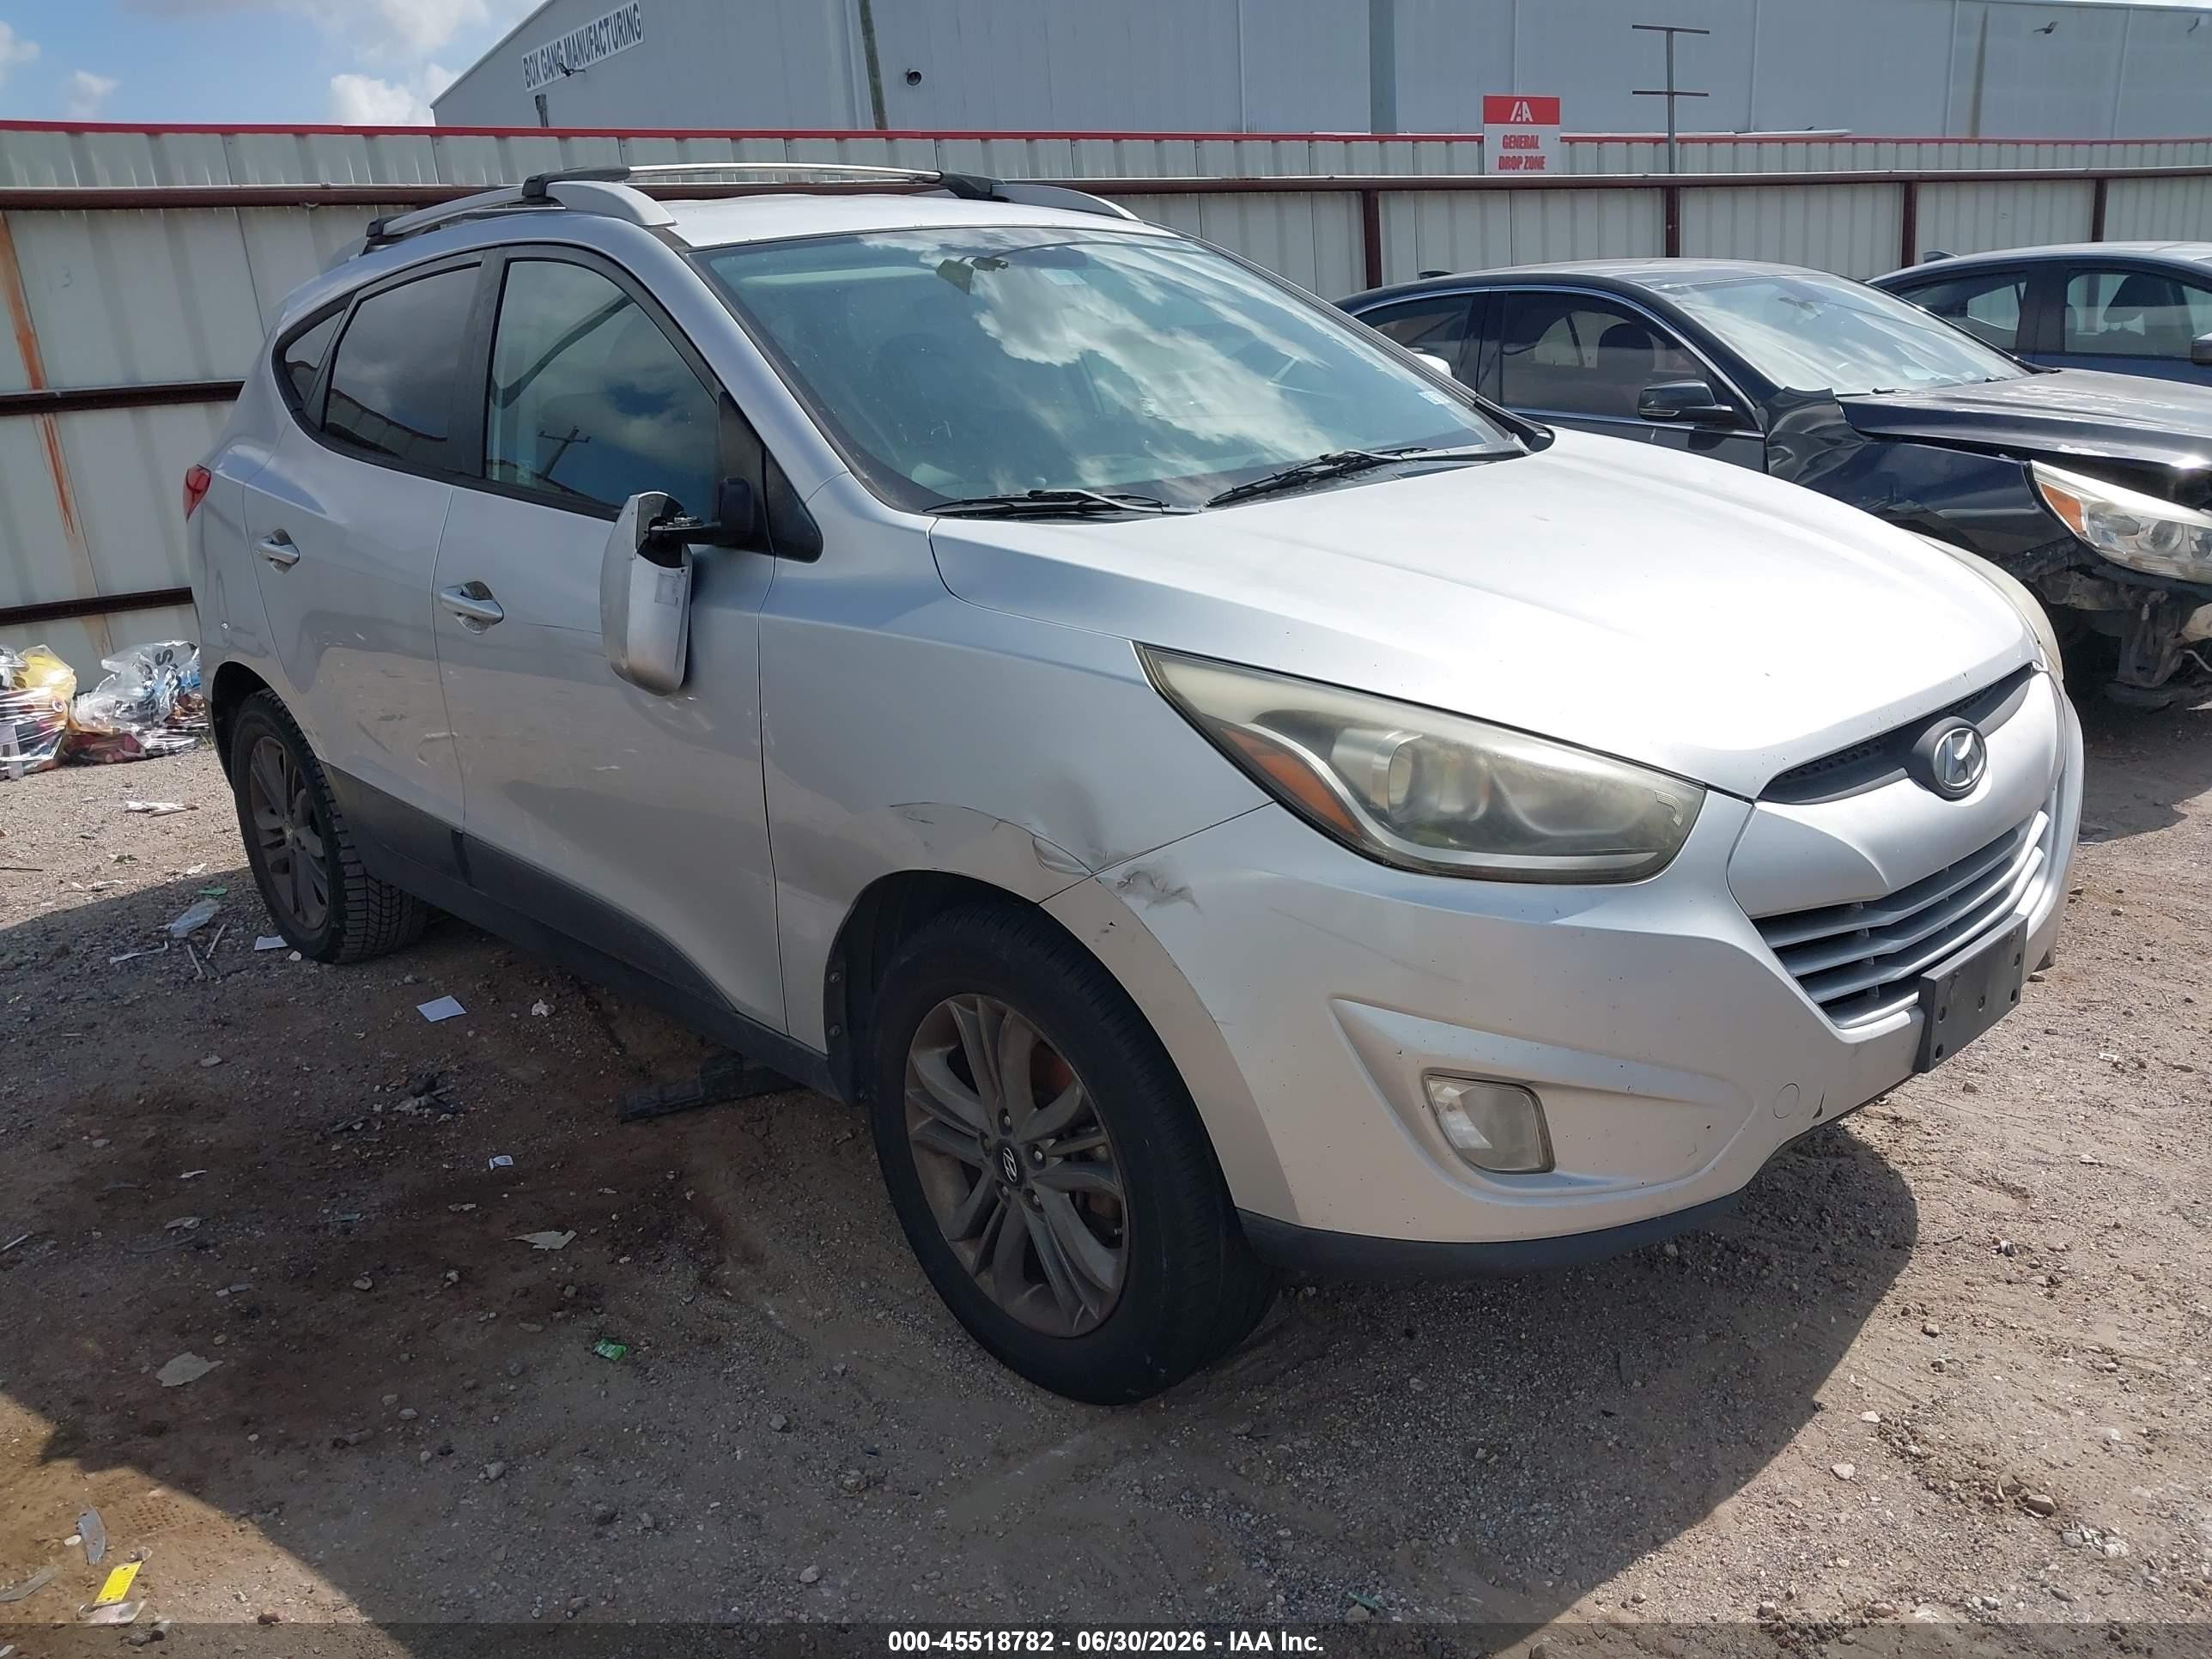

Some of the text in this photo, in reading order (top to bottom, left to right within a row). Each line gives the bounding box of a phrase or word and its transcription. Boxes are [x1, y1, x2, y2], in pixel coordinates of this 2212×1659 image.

[523, 3, 642, 88] BOX GANG MANUFACTURING
[1502, 134, 1540, 149] GENERAL
[1498, 155, 1546, 171] DROP ZONE
